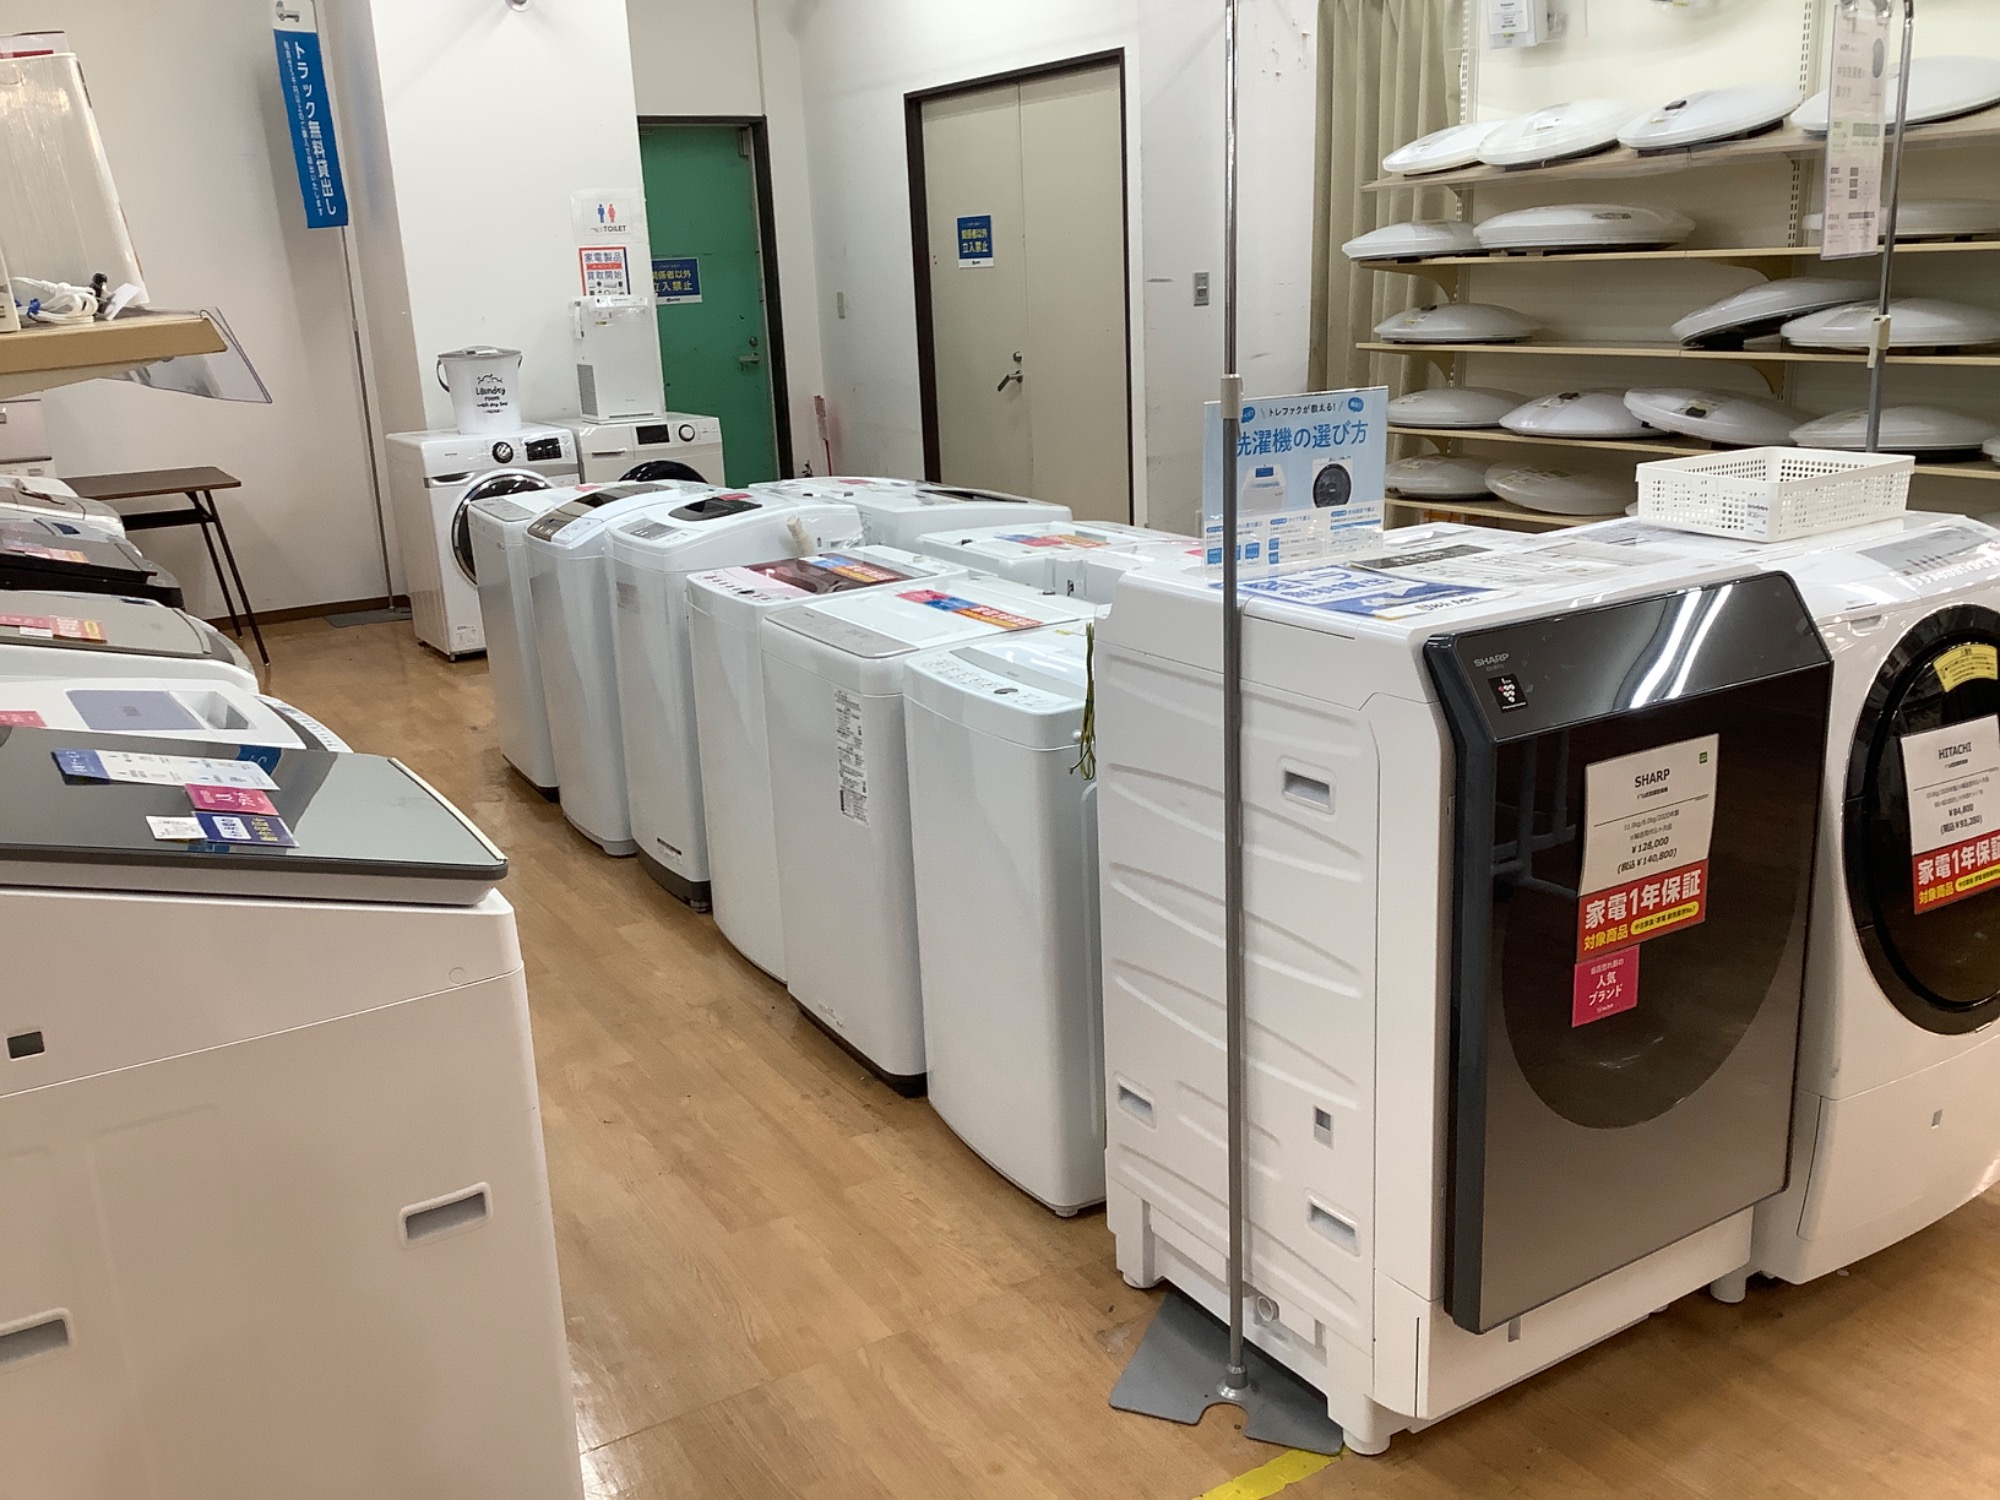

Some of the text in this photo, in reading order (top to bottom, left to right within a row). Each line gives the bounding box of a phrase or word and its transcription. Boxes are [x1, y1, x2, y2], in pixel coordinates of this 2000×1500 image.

[294, 41, 336, 216] トラック無料貸出し
[603, 225, 627, 233] TOILET
[584, 252, 623, 263] 家電製品
[587, 270, 623, 281] 買取開始
[476, 386, 506, 396] Laundry
[1474, 653, 1510, 668] SHARP
[1938, 741, 1972, 760] HITACHI
[1634, 768, 1671, 789] SHARP
[1584, 868, 1702, 930] 家電1年保証
[1583, 923, 1630, 952] 対象商品
[1596, 971, 1618, 990] 人気
[1588, 983, 1623, 1007] ブランド
